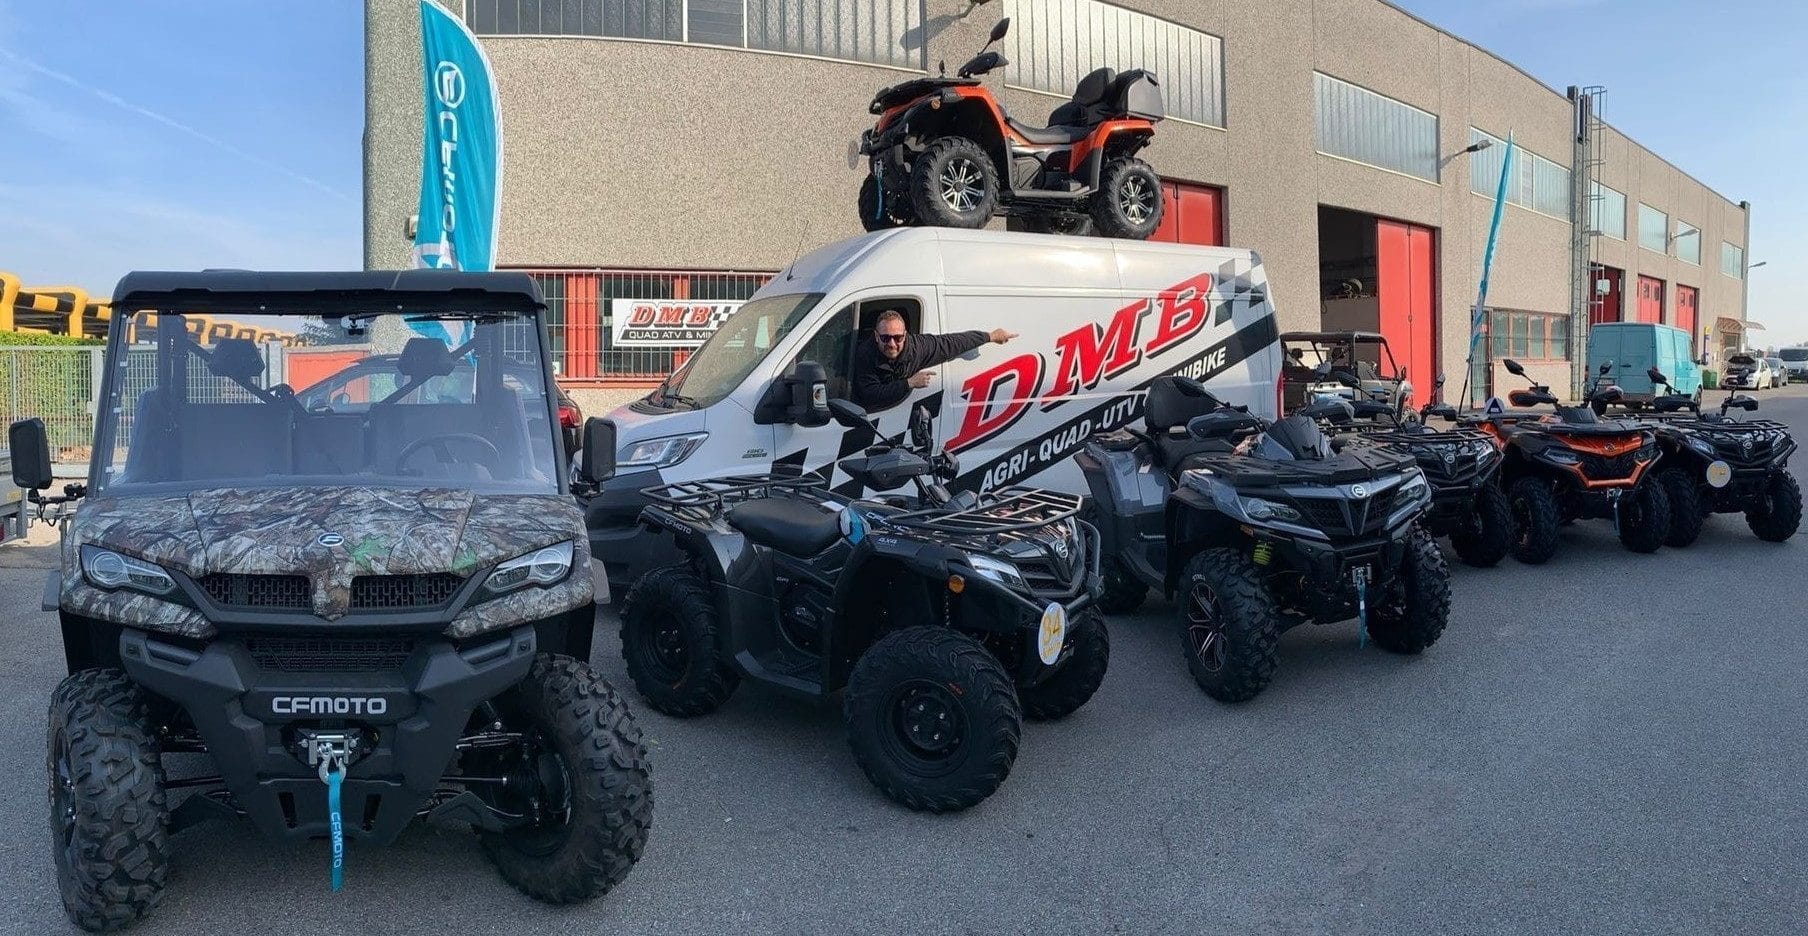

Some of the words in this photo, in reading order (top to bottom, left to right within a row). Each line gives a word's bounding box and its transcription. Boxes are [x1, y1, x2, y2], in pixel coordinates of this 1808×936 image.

[628, 305, 712, 328] DMB
[628, 331, 659, 339] QUAD
[661, 331, 682, 339] ATV
[685, 331, 693, 339] &
[944, 272, 1214, 455] DMB
[1039, 419, 1091, 461] QUAD
[272, 697, 387, 715] CFMOTO
[331, 812, 343, 868] CFMOTO
